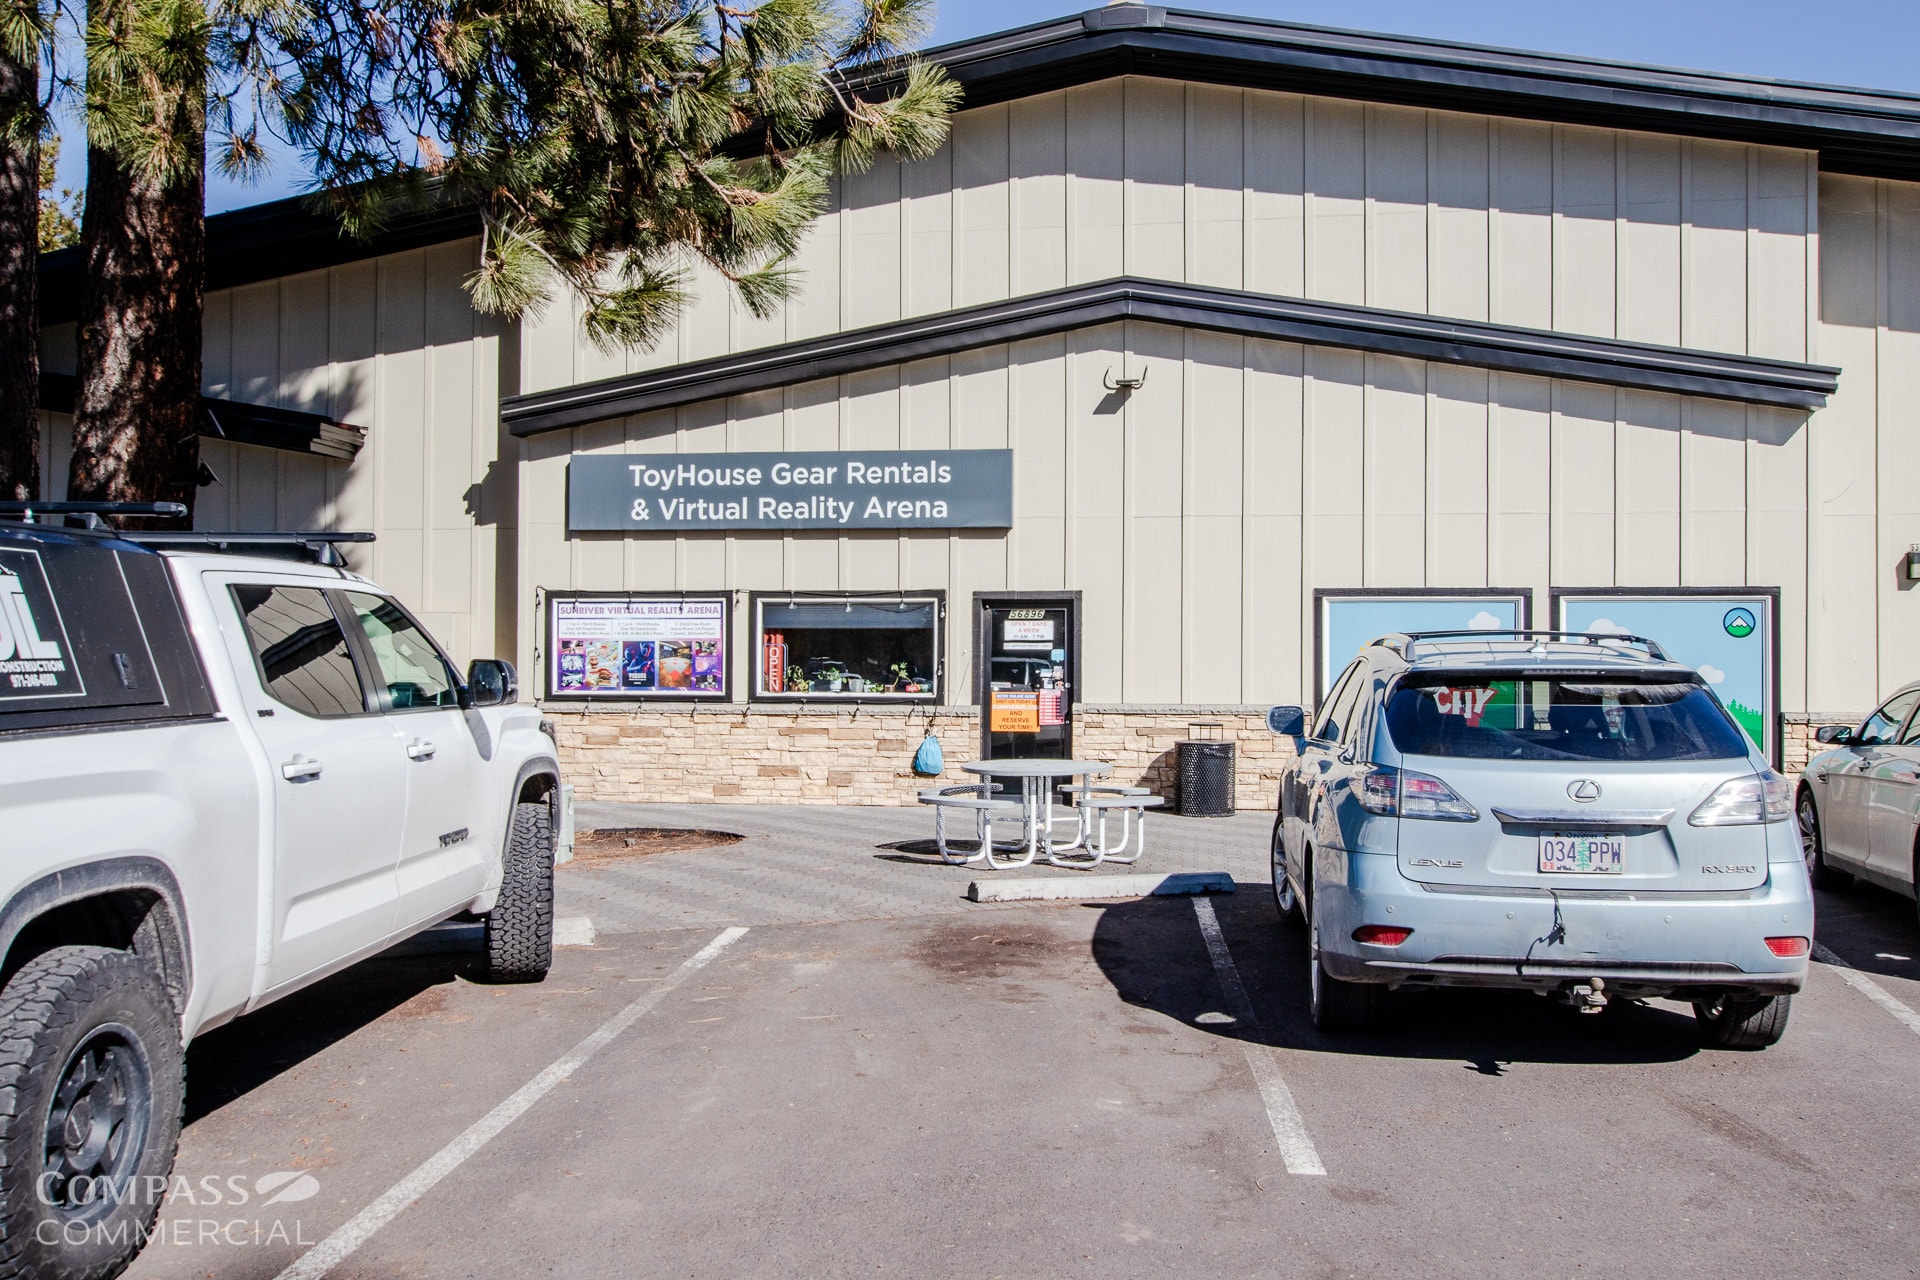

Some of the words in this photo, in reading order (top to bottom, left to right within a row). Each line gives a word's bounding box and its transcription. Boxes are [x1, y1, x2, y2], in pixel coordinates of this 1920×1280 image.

[629, 464, 762, 491] ToyHouse
[771, 462, 838, 485] Gear
[847, 460, 952, 484] Rentals
[630, 498, 650, 521] &
[658, 496, 748, 521] Virtual
[758, 495, 855, 523] Reality
[863, 496, 948, 519] Arena
[560, 606, 605, 615] SUNRIVER
[608, 606, 646, 615] VIRTUAL
[687, 606, 719, 615] ARENA
[1010, 609, 1044, 618] 56896
[0, 659, 66, 674] ONSTRUCTION
[769, 647, 779, 691] OPEN
[1566, 832, 1598, 840] Oregon
[1544, 840, 1577, 863] 034
[1588, 841, 1622, 864] PPW
[1408, 858, 1465, 869] LEXUS
